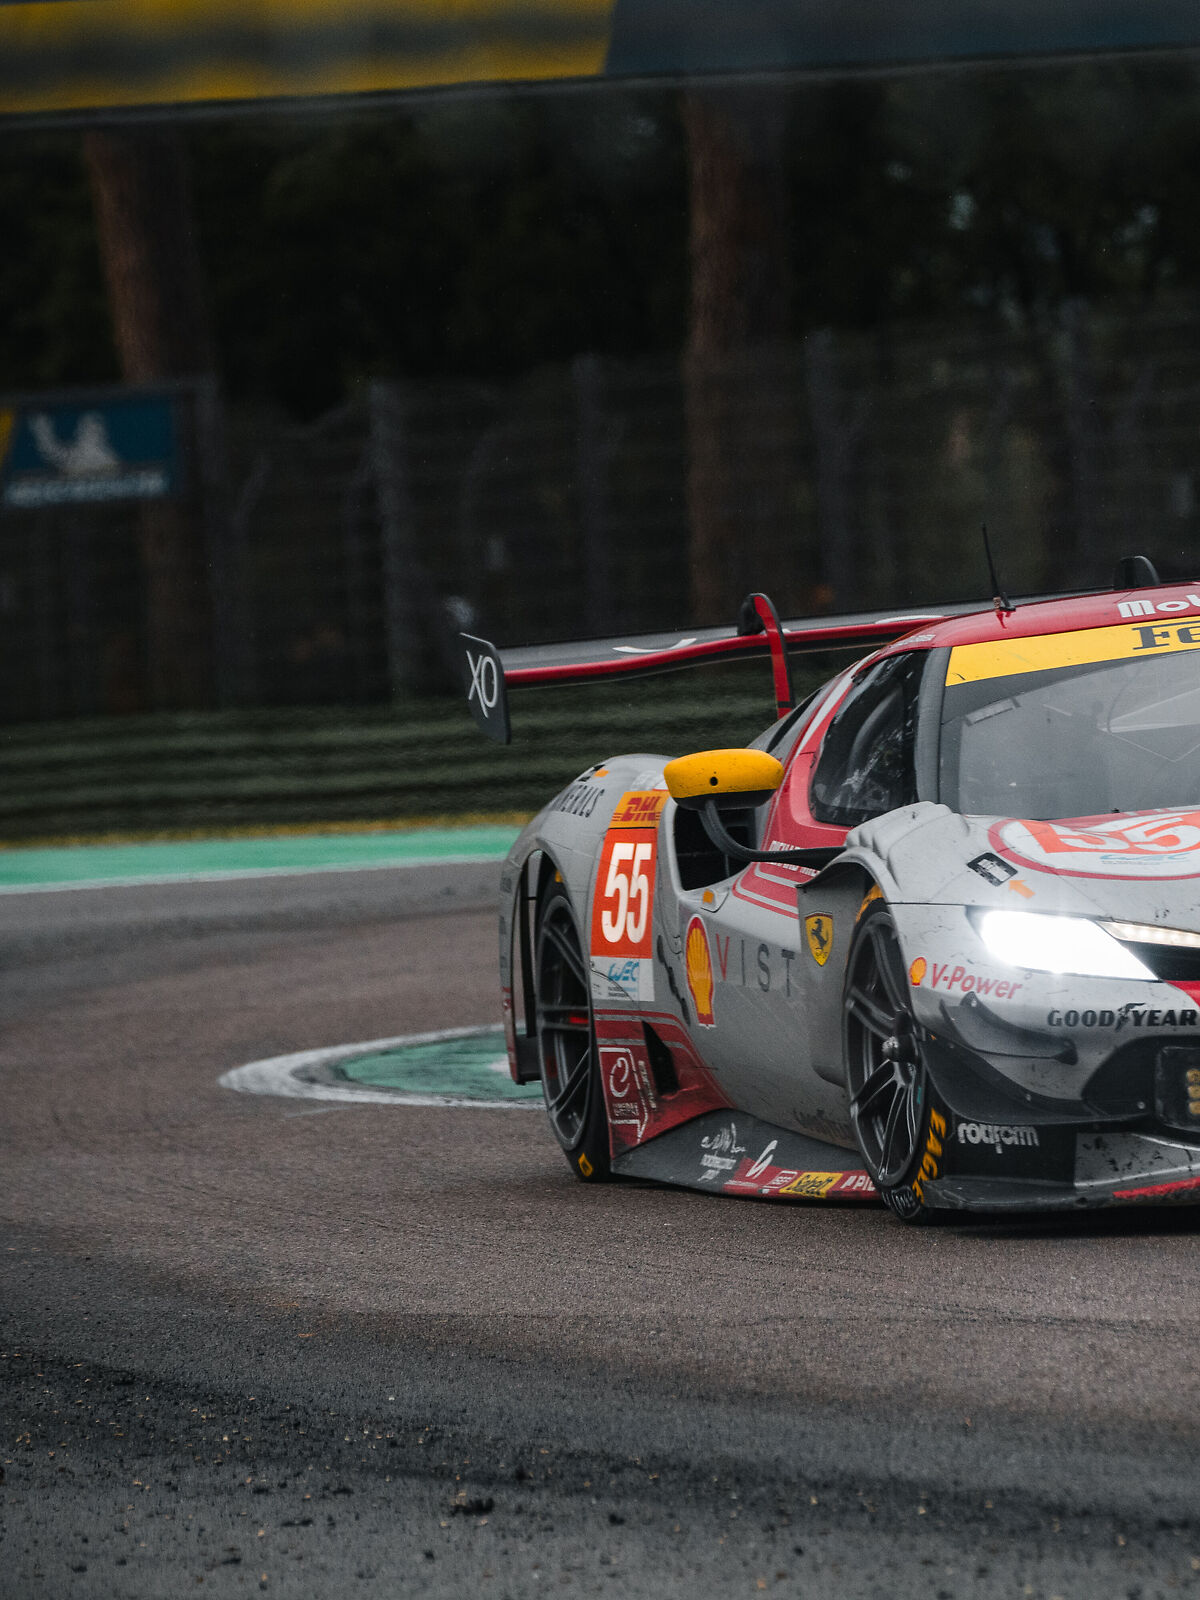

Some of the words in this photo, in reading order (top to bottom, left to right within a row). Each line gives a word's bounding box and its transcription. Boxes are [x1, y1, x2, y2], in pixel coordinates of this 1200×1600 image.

[465, 650, 498, 718] XO
[621, 796, 662, 822] DHL
[601, 842, 653, 943] 55
[932, 963, 1023, 999] V-Power
